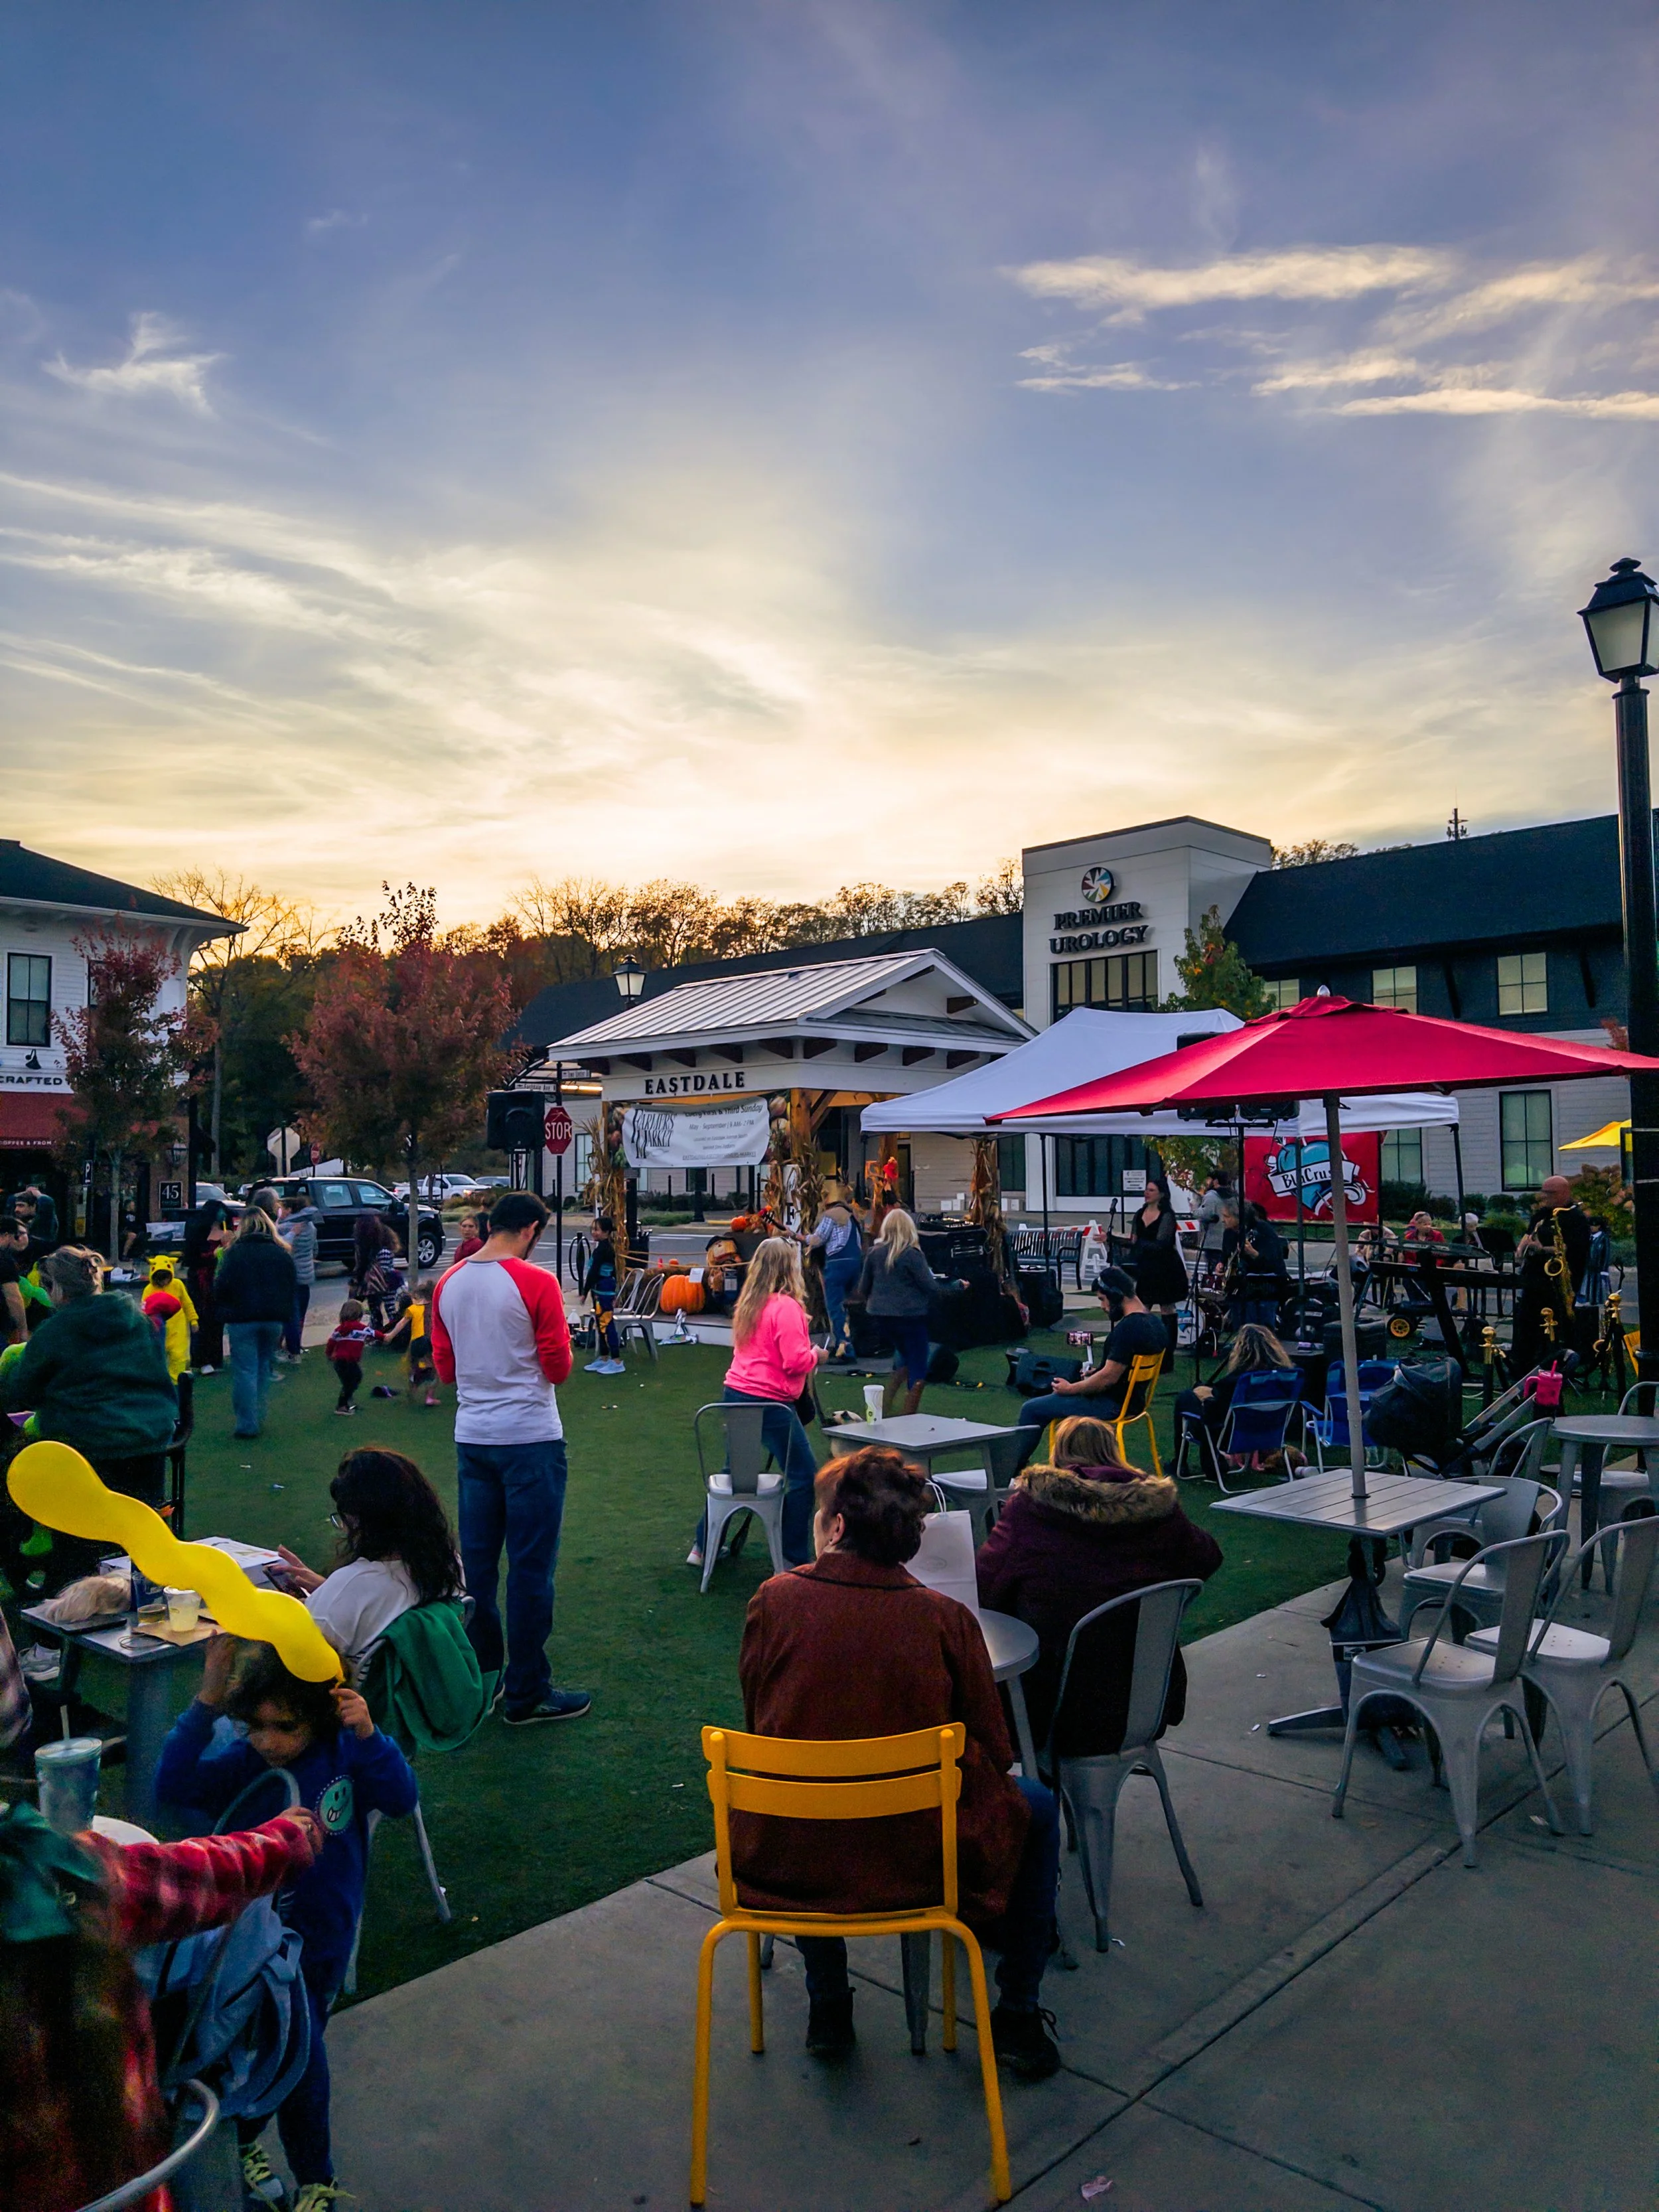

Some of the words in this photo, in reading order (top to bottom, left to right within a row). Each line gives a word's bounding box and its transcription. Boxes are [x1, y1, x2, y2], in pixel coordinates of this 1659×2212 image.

[1054, 901, 1144, 930] PREMIER
[1048, 924, 1149, 954] UROLOGY
[644, 1071, 745, 1094] EASTDALE
[724, 1106, 740, 1114] Third
[741, 1103, 763, 1113] Sunday
[545, 1122, 571, 1140] STOP
[703, 1122, 727, 1130] September
[636, 1130, 673, 1159] MARKET
[161, 1185, 179, 1199] 45
